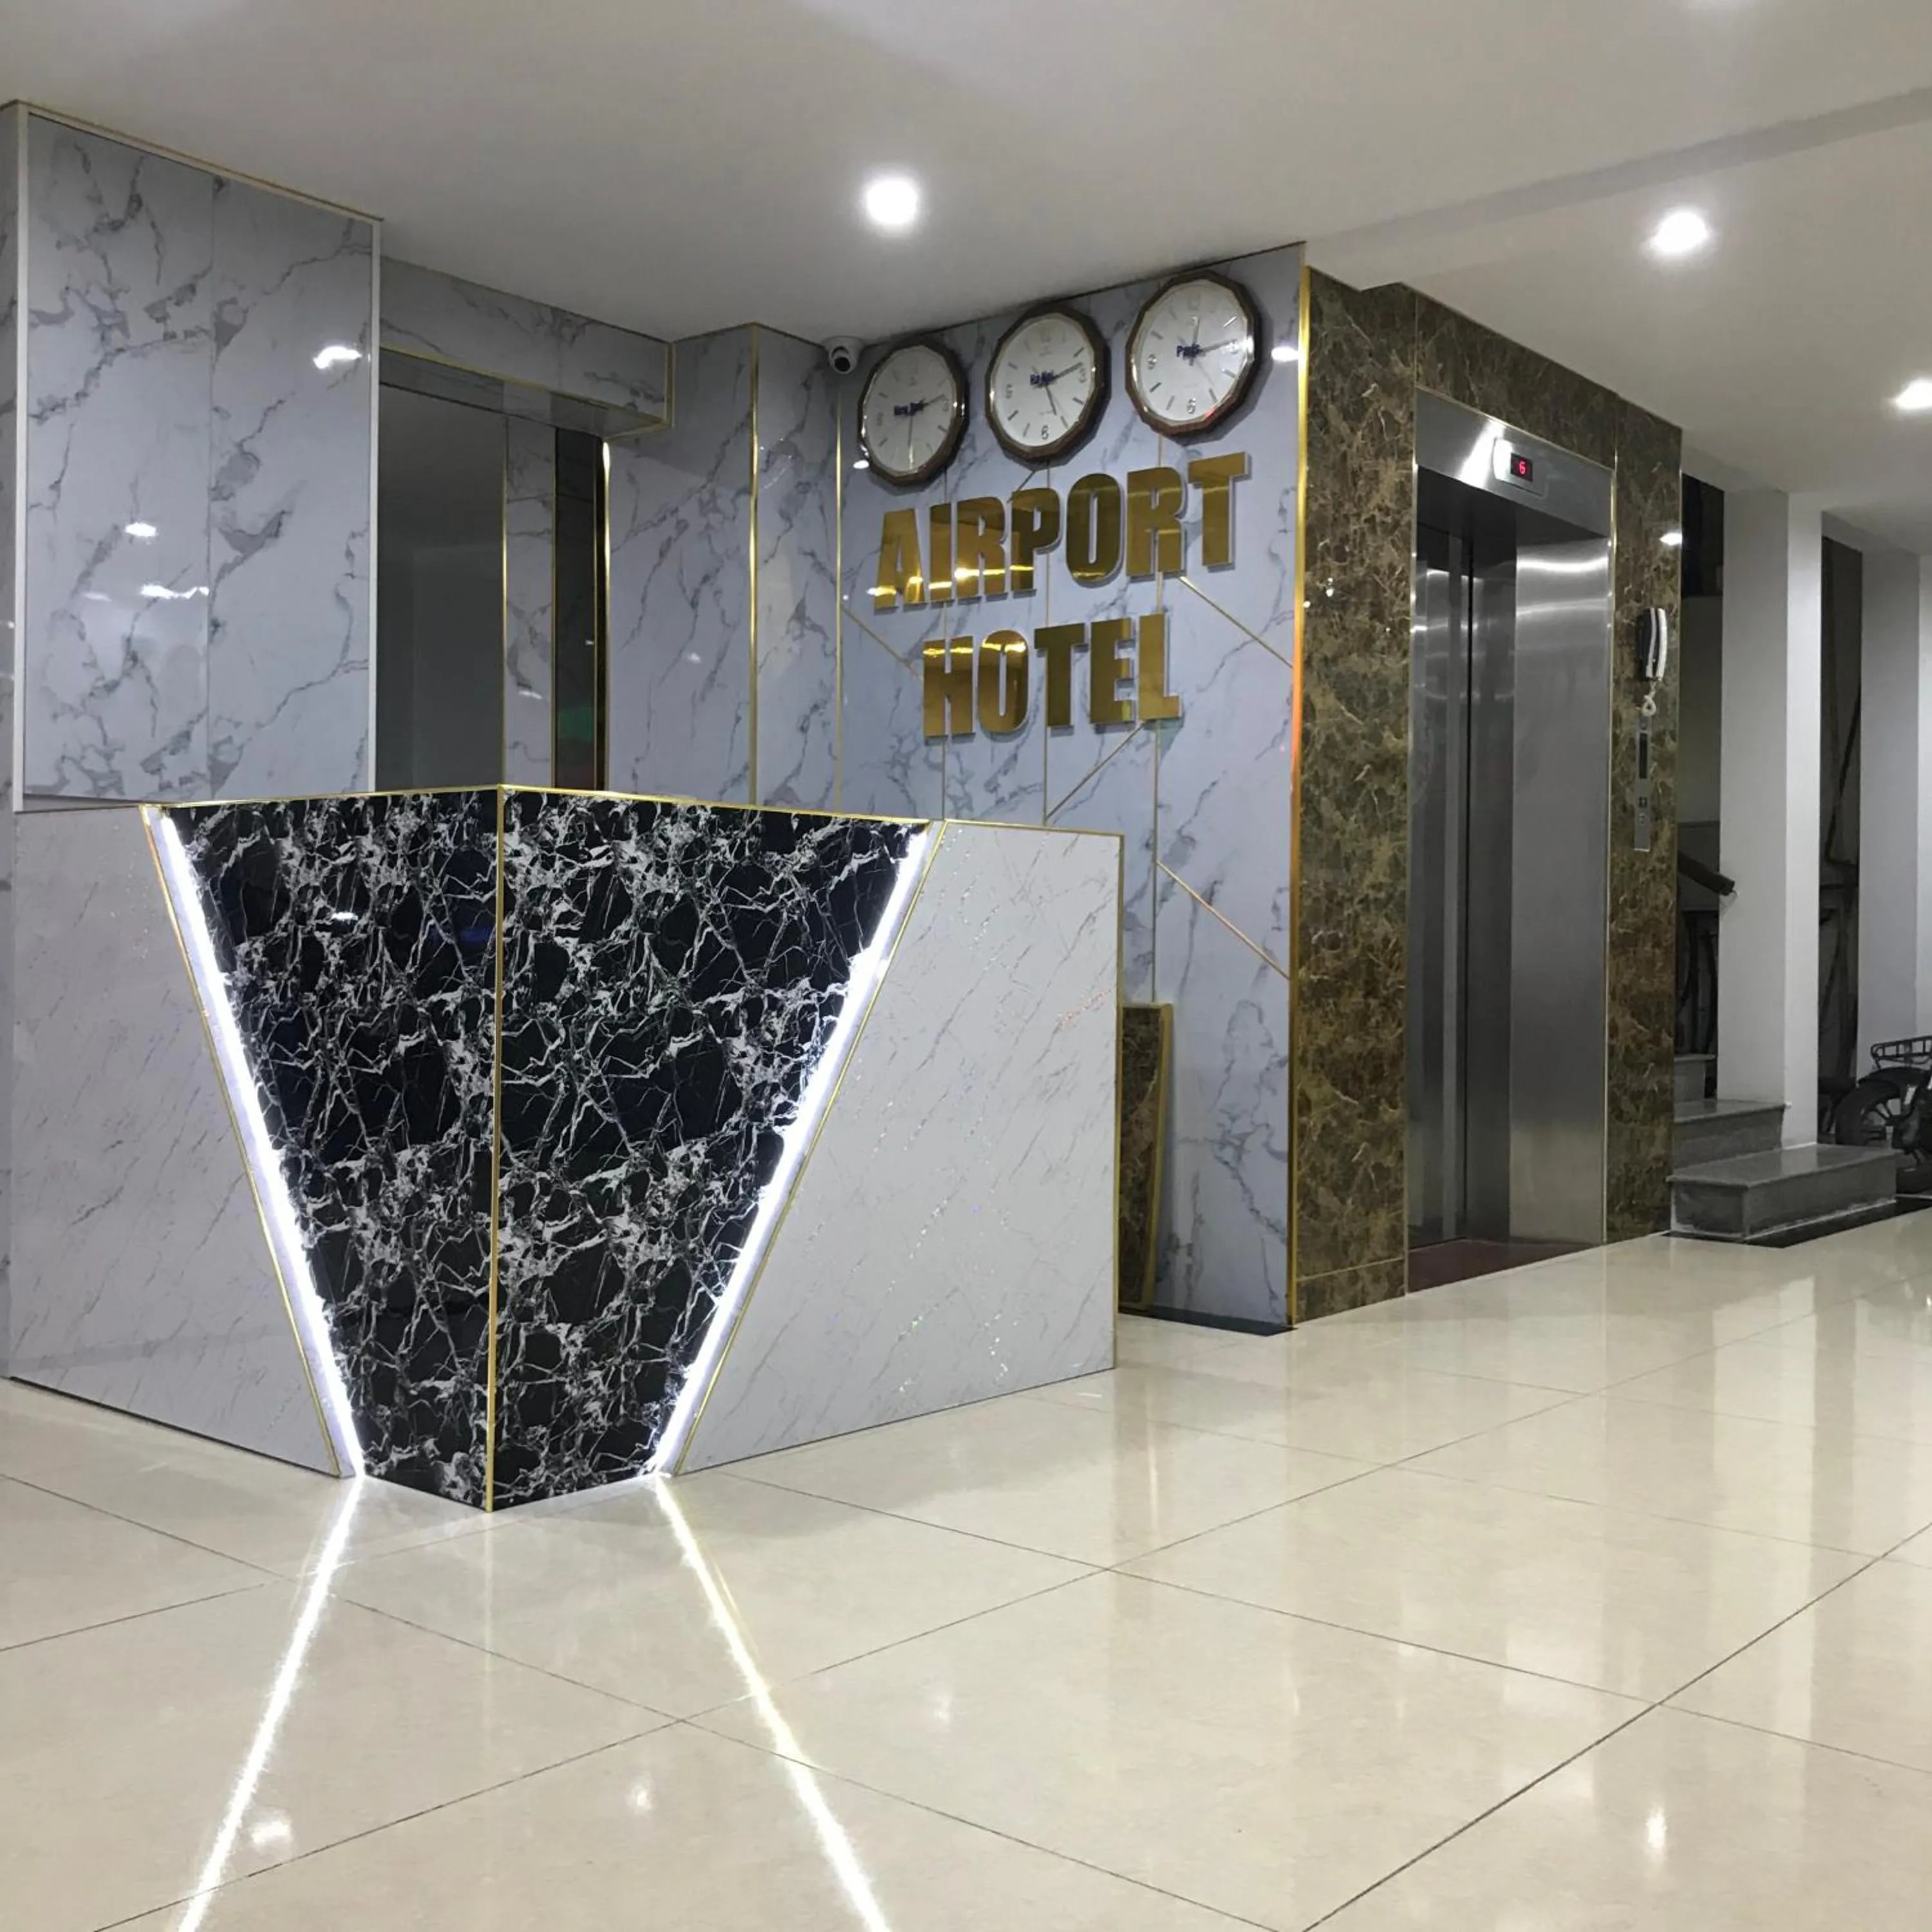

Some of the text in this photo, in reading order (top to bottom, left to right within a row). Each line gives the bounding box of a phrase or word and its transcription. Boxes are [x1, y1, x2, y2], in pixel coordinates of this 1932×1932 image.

[1519, 460, 1526, 475] 6
[874, 452, 1249, 610] AIRPORT
[923, 614, 1182, 739] HOTEL
